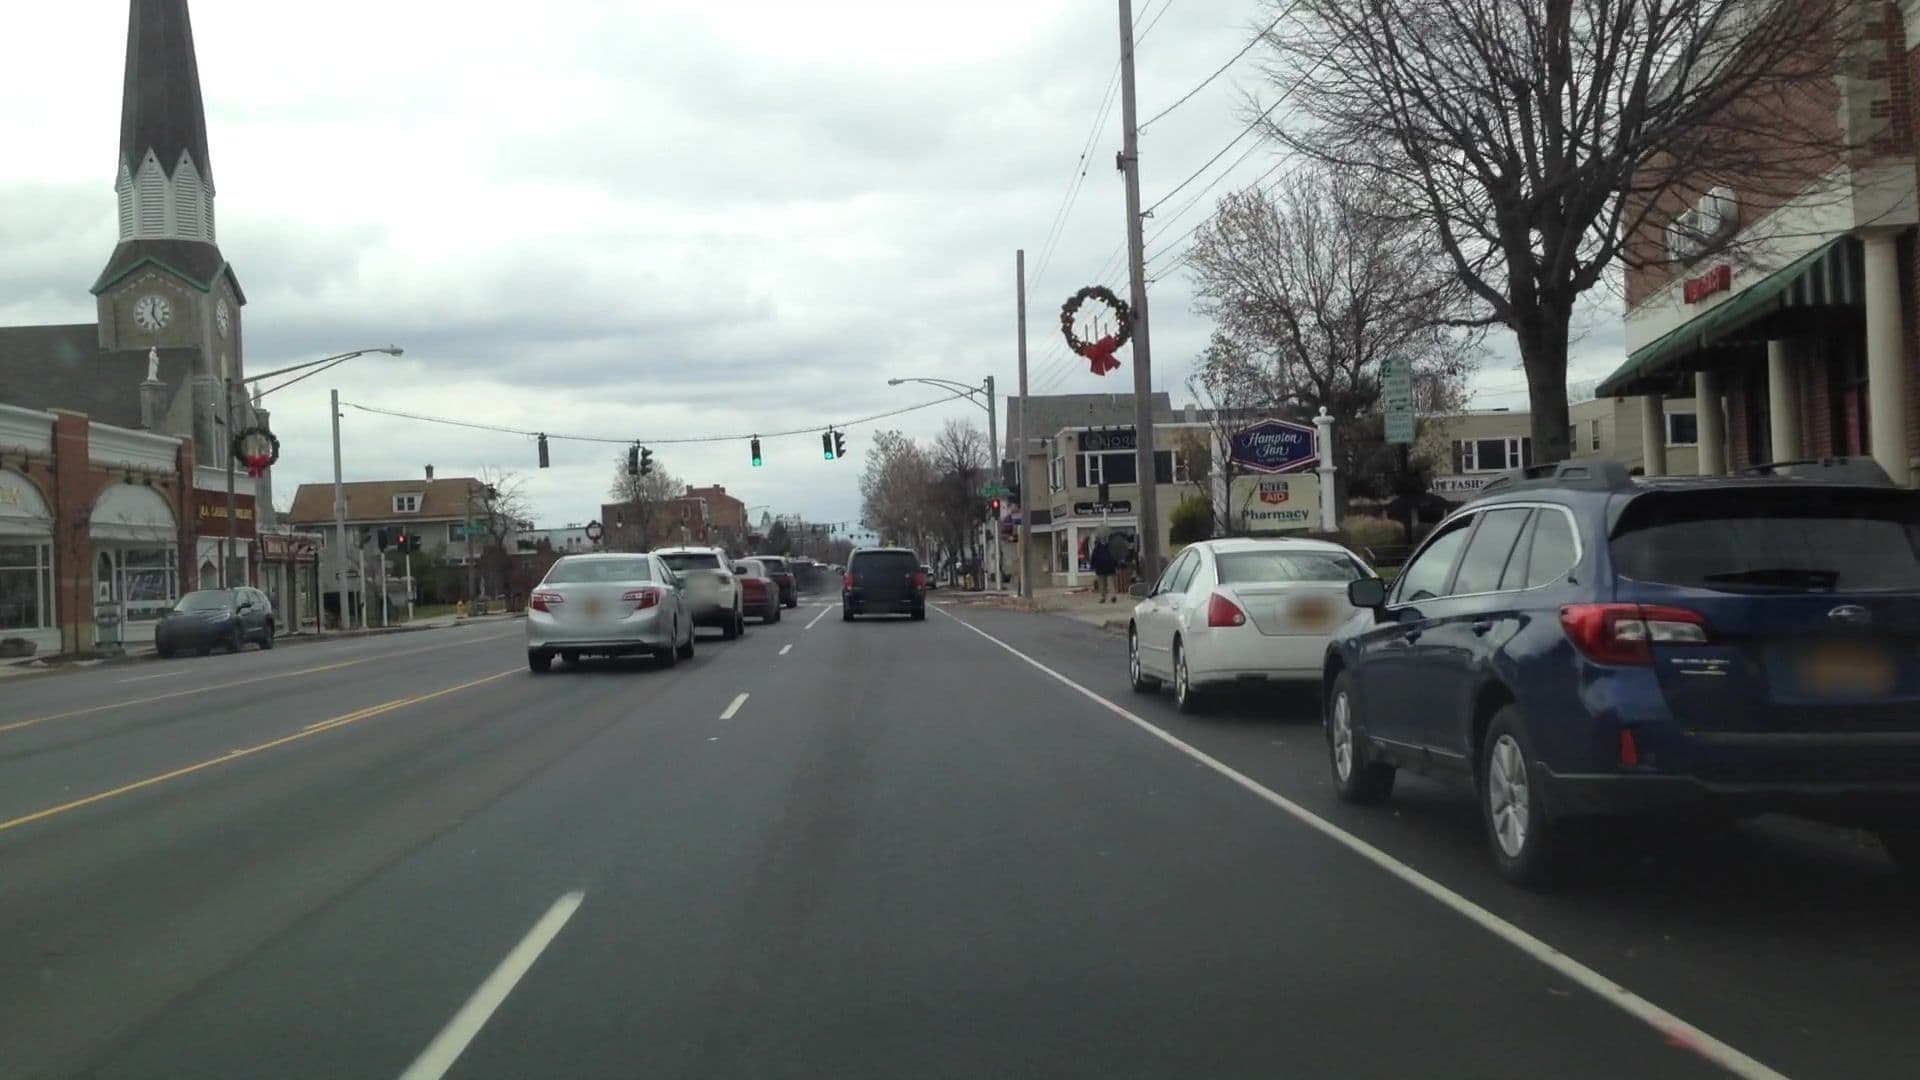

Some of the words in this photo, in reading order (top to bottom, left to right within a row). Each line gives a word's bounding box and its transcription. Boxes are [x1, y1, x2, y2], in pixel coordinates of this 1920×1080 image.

[1242, 432, 1303, 448] Hampton
[1256, 445, 1289, 457] Inn
[1261, 482, 1288, 492] RITE
[1266, 493, 1286, 501] AID
[1242, 509, 1309, 520] Pharmacy
